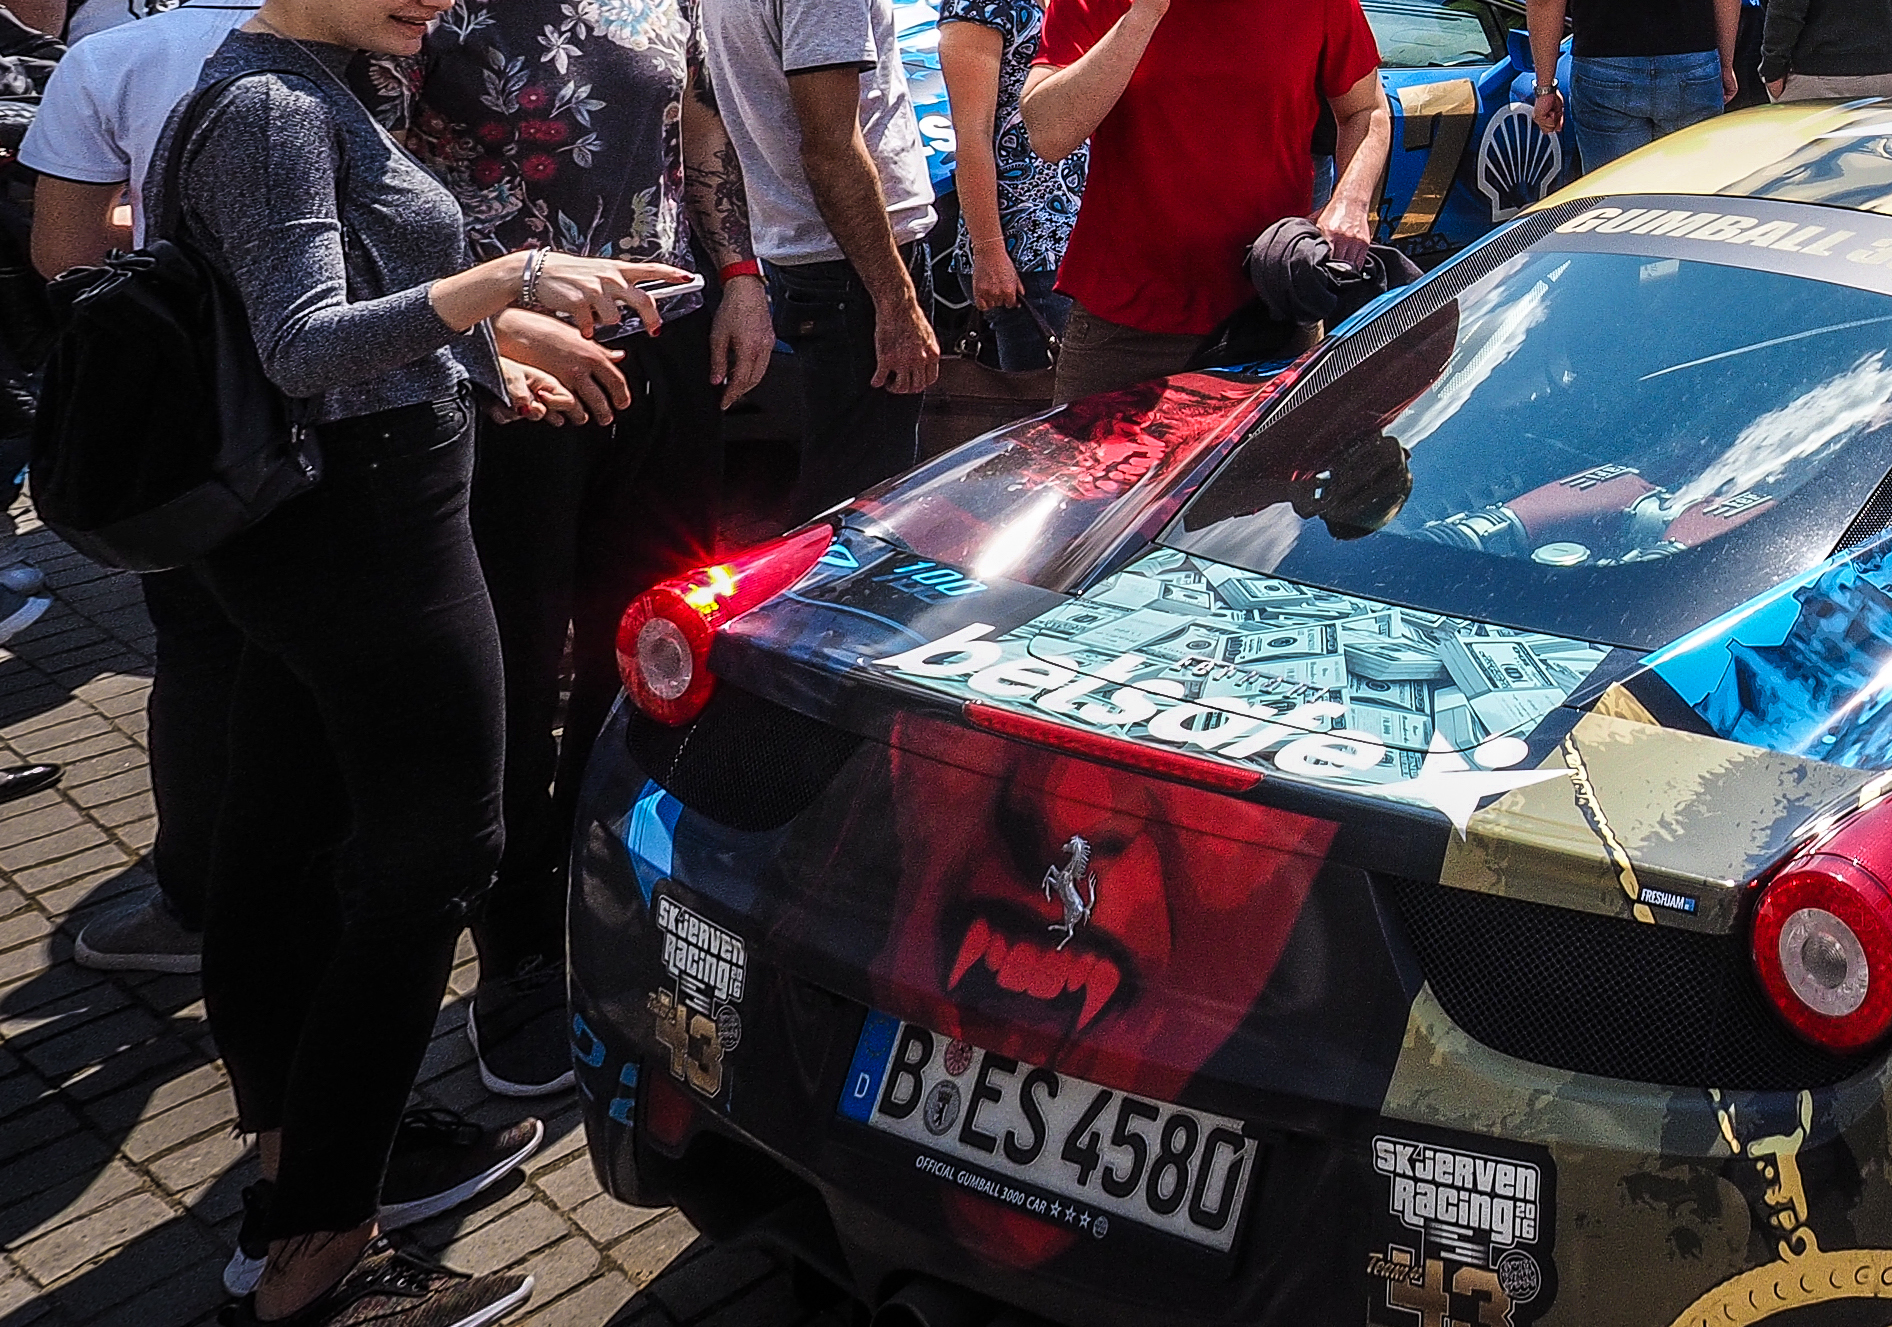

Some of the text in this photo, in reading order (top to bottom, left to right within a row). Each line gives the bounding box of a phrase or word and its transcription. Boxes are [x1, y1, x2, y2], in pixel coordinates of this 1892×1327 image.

[1555, 207, 1857, 257] GUMBALL
[873, 623, 1388, 774] betsafe
[1640, 887, 1685, 911] FRESHJAM
[656, 989, 723, 1094] 43
[853, 1072, 871, 1100] D
[877, 1023, 1247, 1231] B ES 4580
[915, 1155, 1048, 1216] OFFICIAL GUMBALL 3000 CAR
